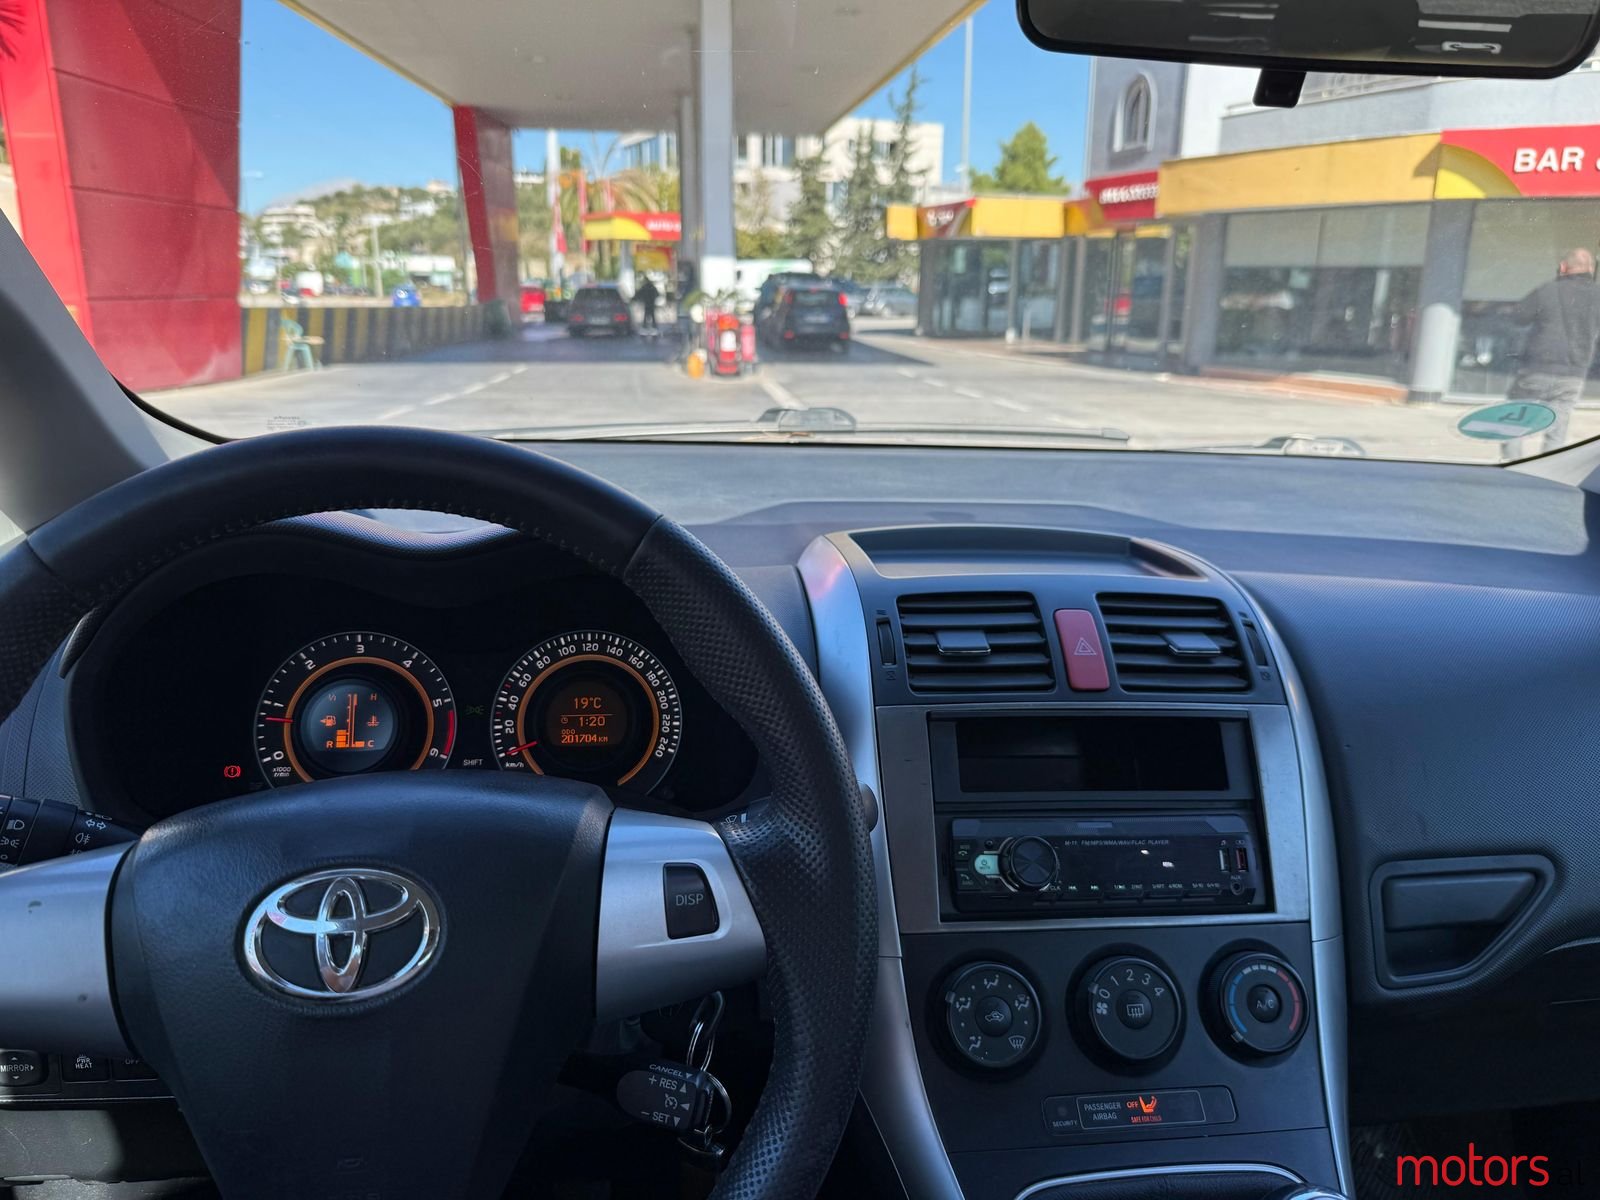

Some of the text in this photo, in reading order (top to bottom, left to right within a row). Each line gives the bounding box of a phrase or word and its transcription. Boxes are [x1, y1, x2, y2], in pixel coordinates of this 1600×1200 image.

[1514, 146, 1585, 173] BAR
[356, 644, 365, 654] 3
[558, 644, 576, 657] 100
[582, 643, 599, 652] 120
[606, 645, 624, 656] 140
[304, 660, 316, 670] 2
[402, 660, 412, 668] 4
[536, 655, 551, 669] 80
[628, 654, 644, 669] 160
[518, 673, 532, 688] 60
[646, 670, 660, 687] 180
[370, 692, 378, 700] H
[656, 690, 669, 710] 200
[433, 698, 442, 707] 5
[508, 695, 519, 710] 40
[574, 696, 602, 709] 19°C
[580, 716, 606, 726] 1:20
[662, 714, 670, 732] 220
[504, 720, 514, 734] 20
[326, 740, 334, 748] R
[368, 740, 374, 748] C
[562, 734, 597, 744] 201704
[655, 737, 668, 758] 240
[273, 750, 284, 760] 0
[430, 748, 438, 758] 6
[463, 758, 484, 766] SHIFT
[675, 894, 704, 906] DISP
[1098, 968, 1165, 998] 0 1 2 3 4
[1256, 1000, 1274, 1010] A/C
[0, 1064, 30, 1072] MIRROR
[649, 1064, 684, 1078] CANCEL
[659, 1078, 678, 1090] RES
[1084, 1102, 1121, 1111] PASSENGER
[652, 1112, 670, 1124] SET
[1092, 1112, 1118, 1120] AIRBAG
[1052, 1120, 1078, 1128] SECURITY
